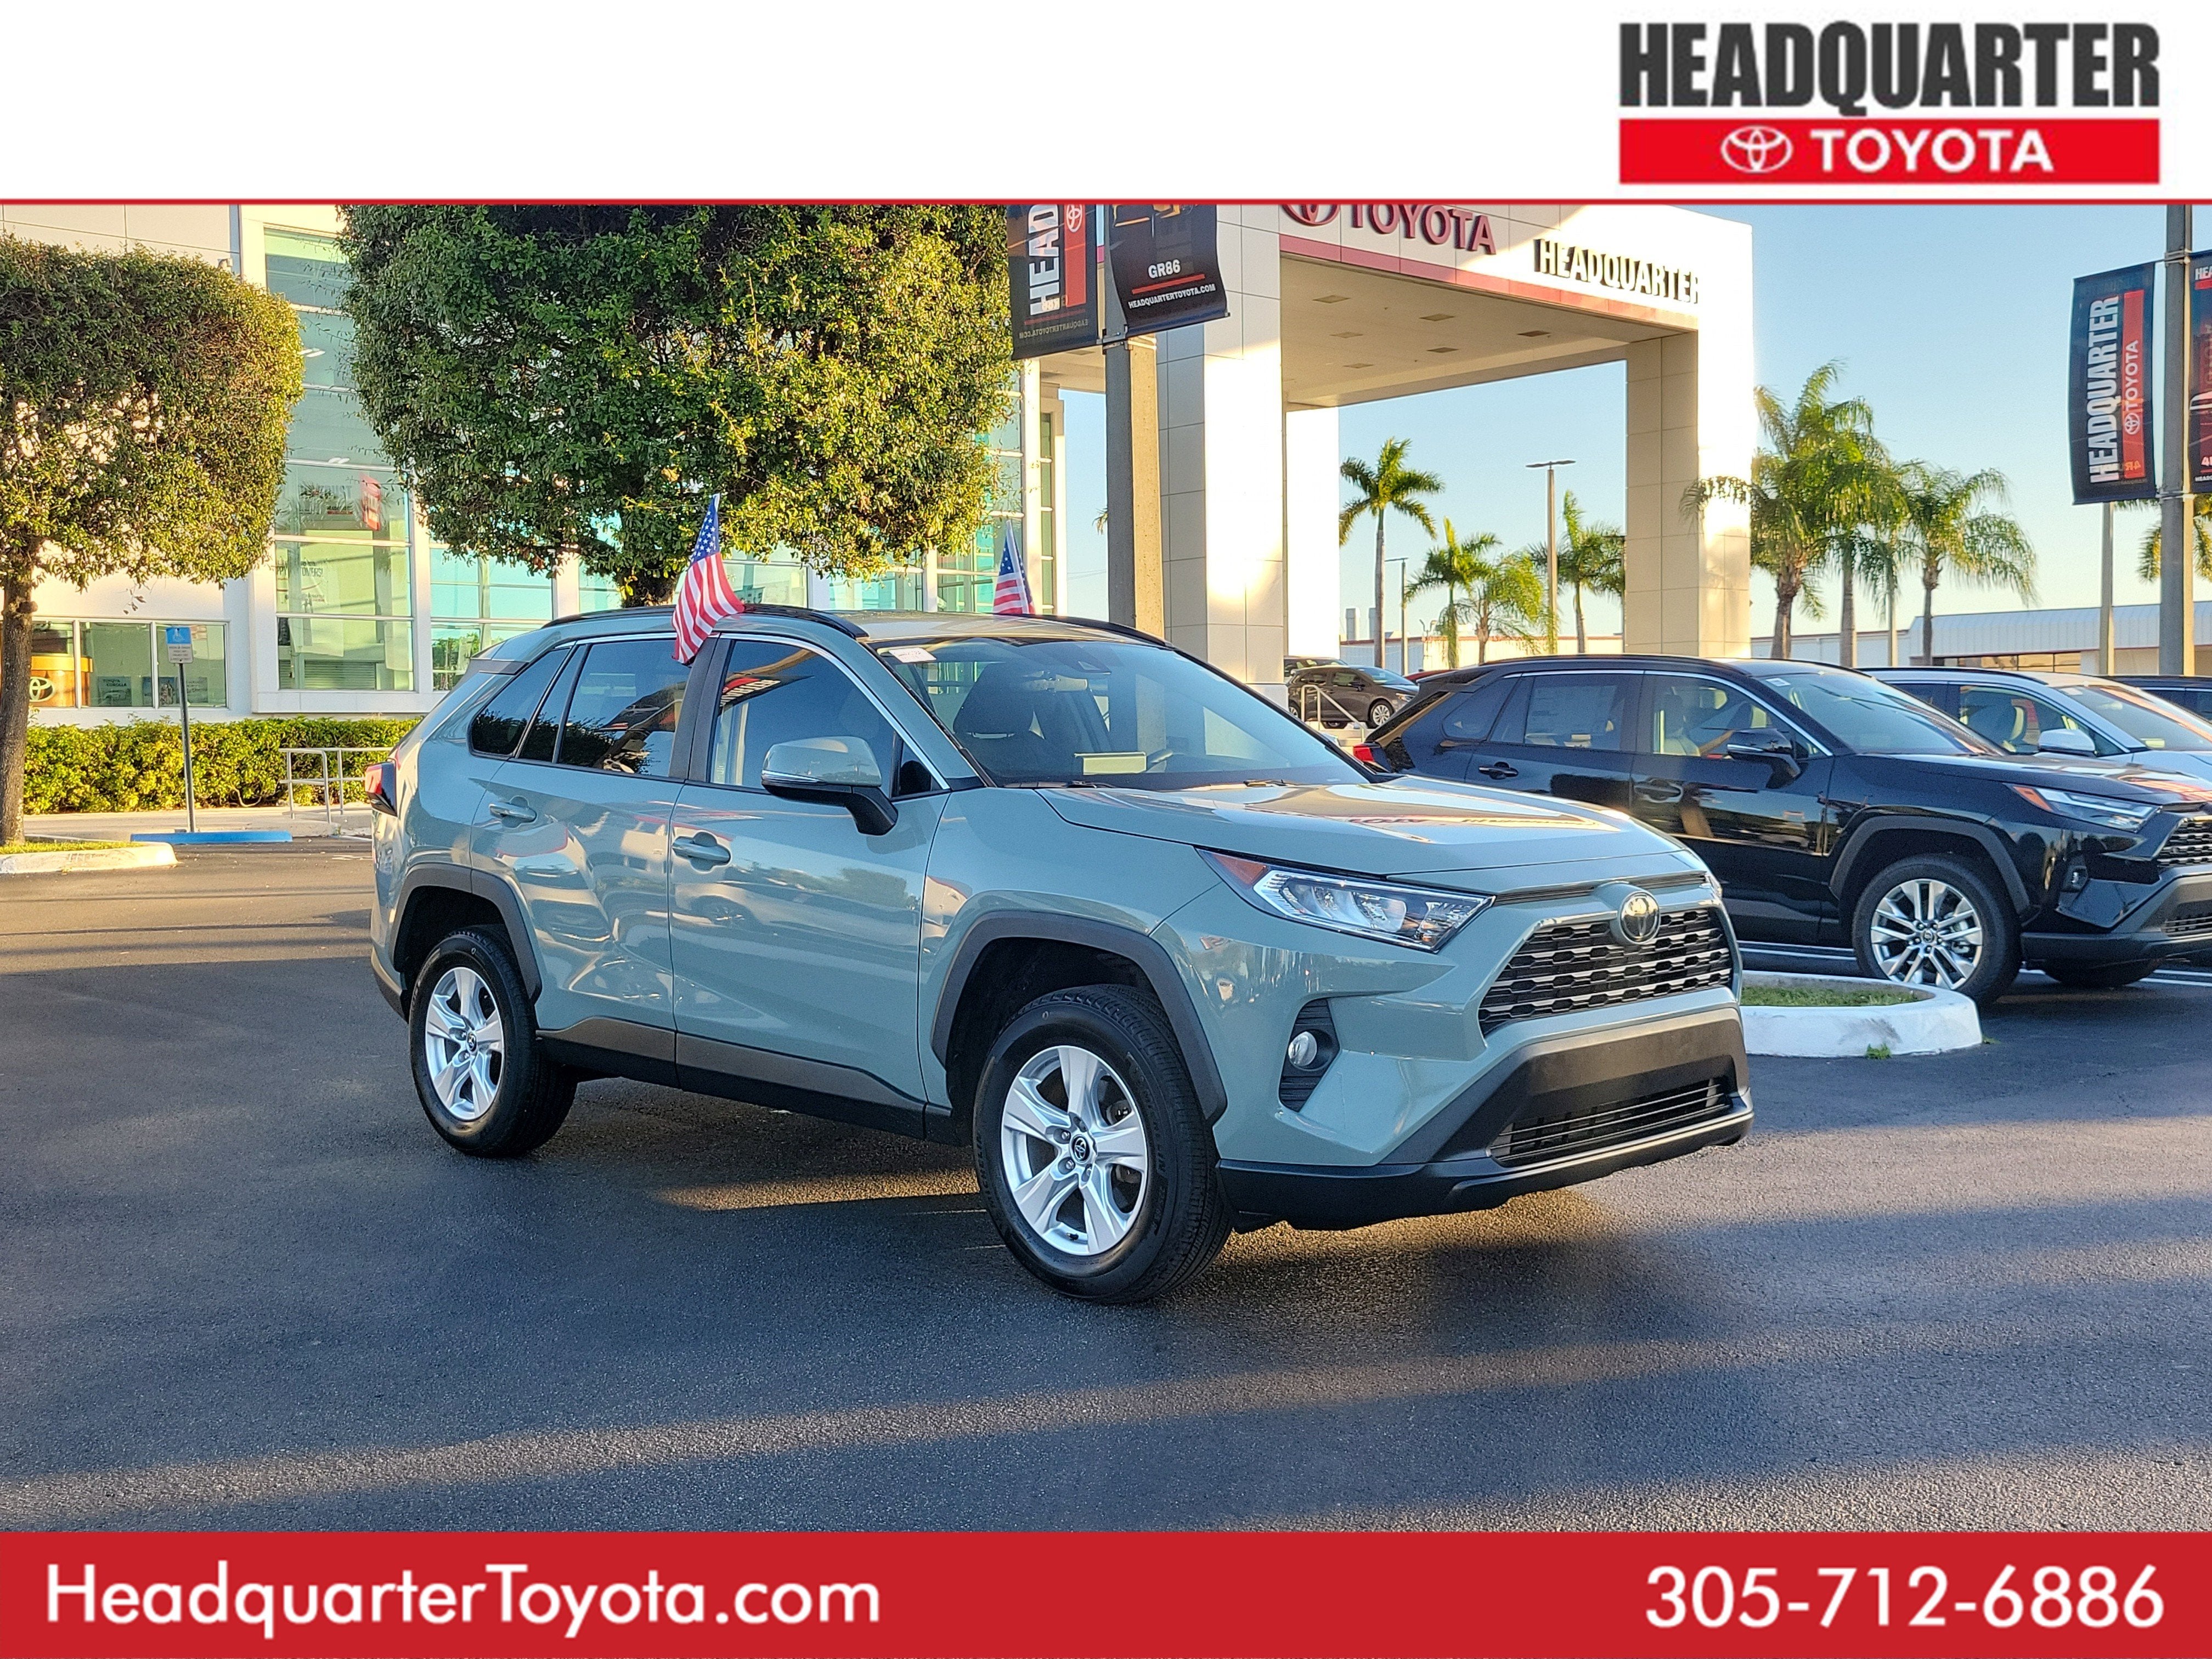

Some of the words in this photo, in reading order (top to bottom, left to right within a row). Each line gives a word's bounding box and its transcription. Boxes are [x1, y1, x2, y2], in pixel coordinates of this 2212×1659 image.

[1128, 284, 1216, 309] HEADQUARTERTOYOTA.COM
[1148, 259, 1180, 278] GR86
[1533, 238, 1699, 304] HEADQUARTER
[2087, 295, 2119, 483] HEADQUARTER
[2125, 340, 2139, 411] TOYOTA
